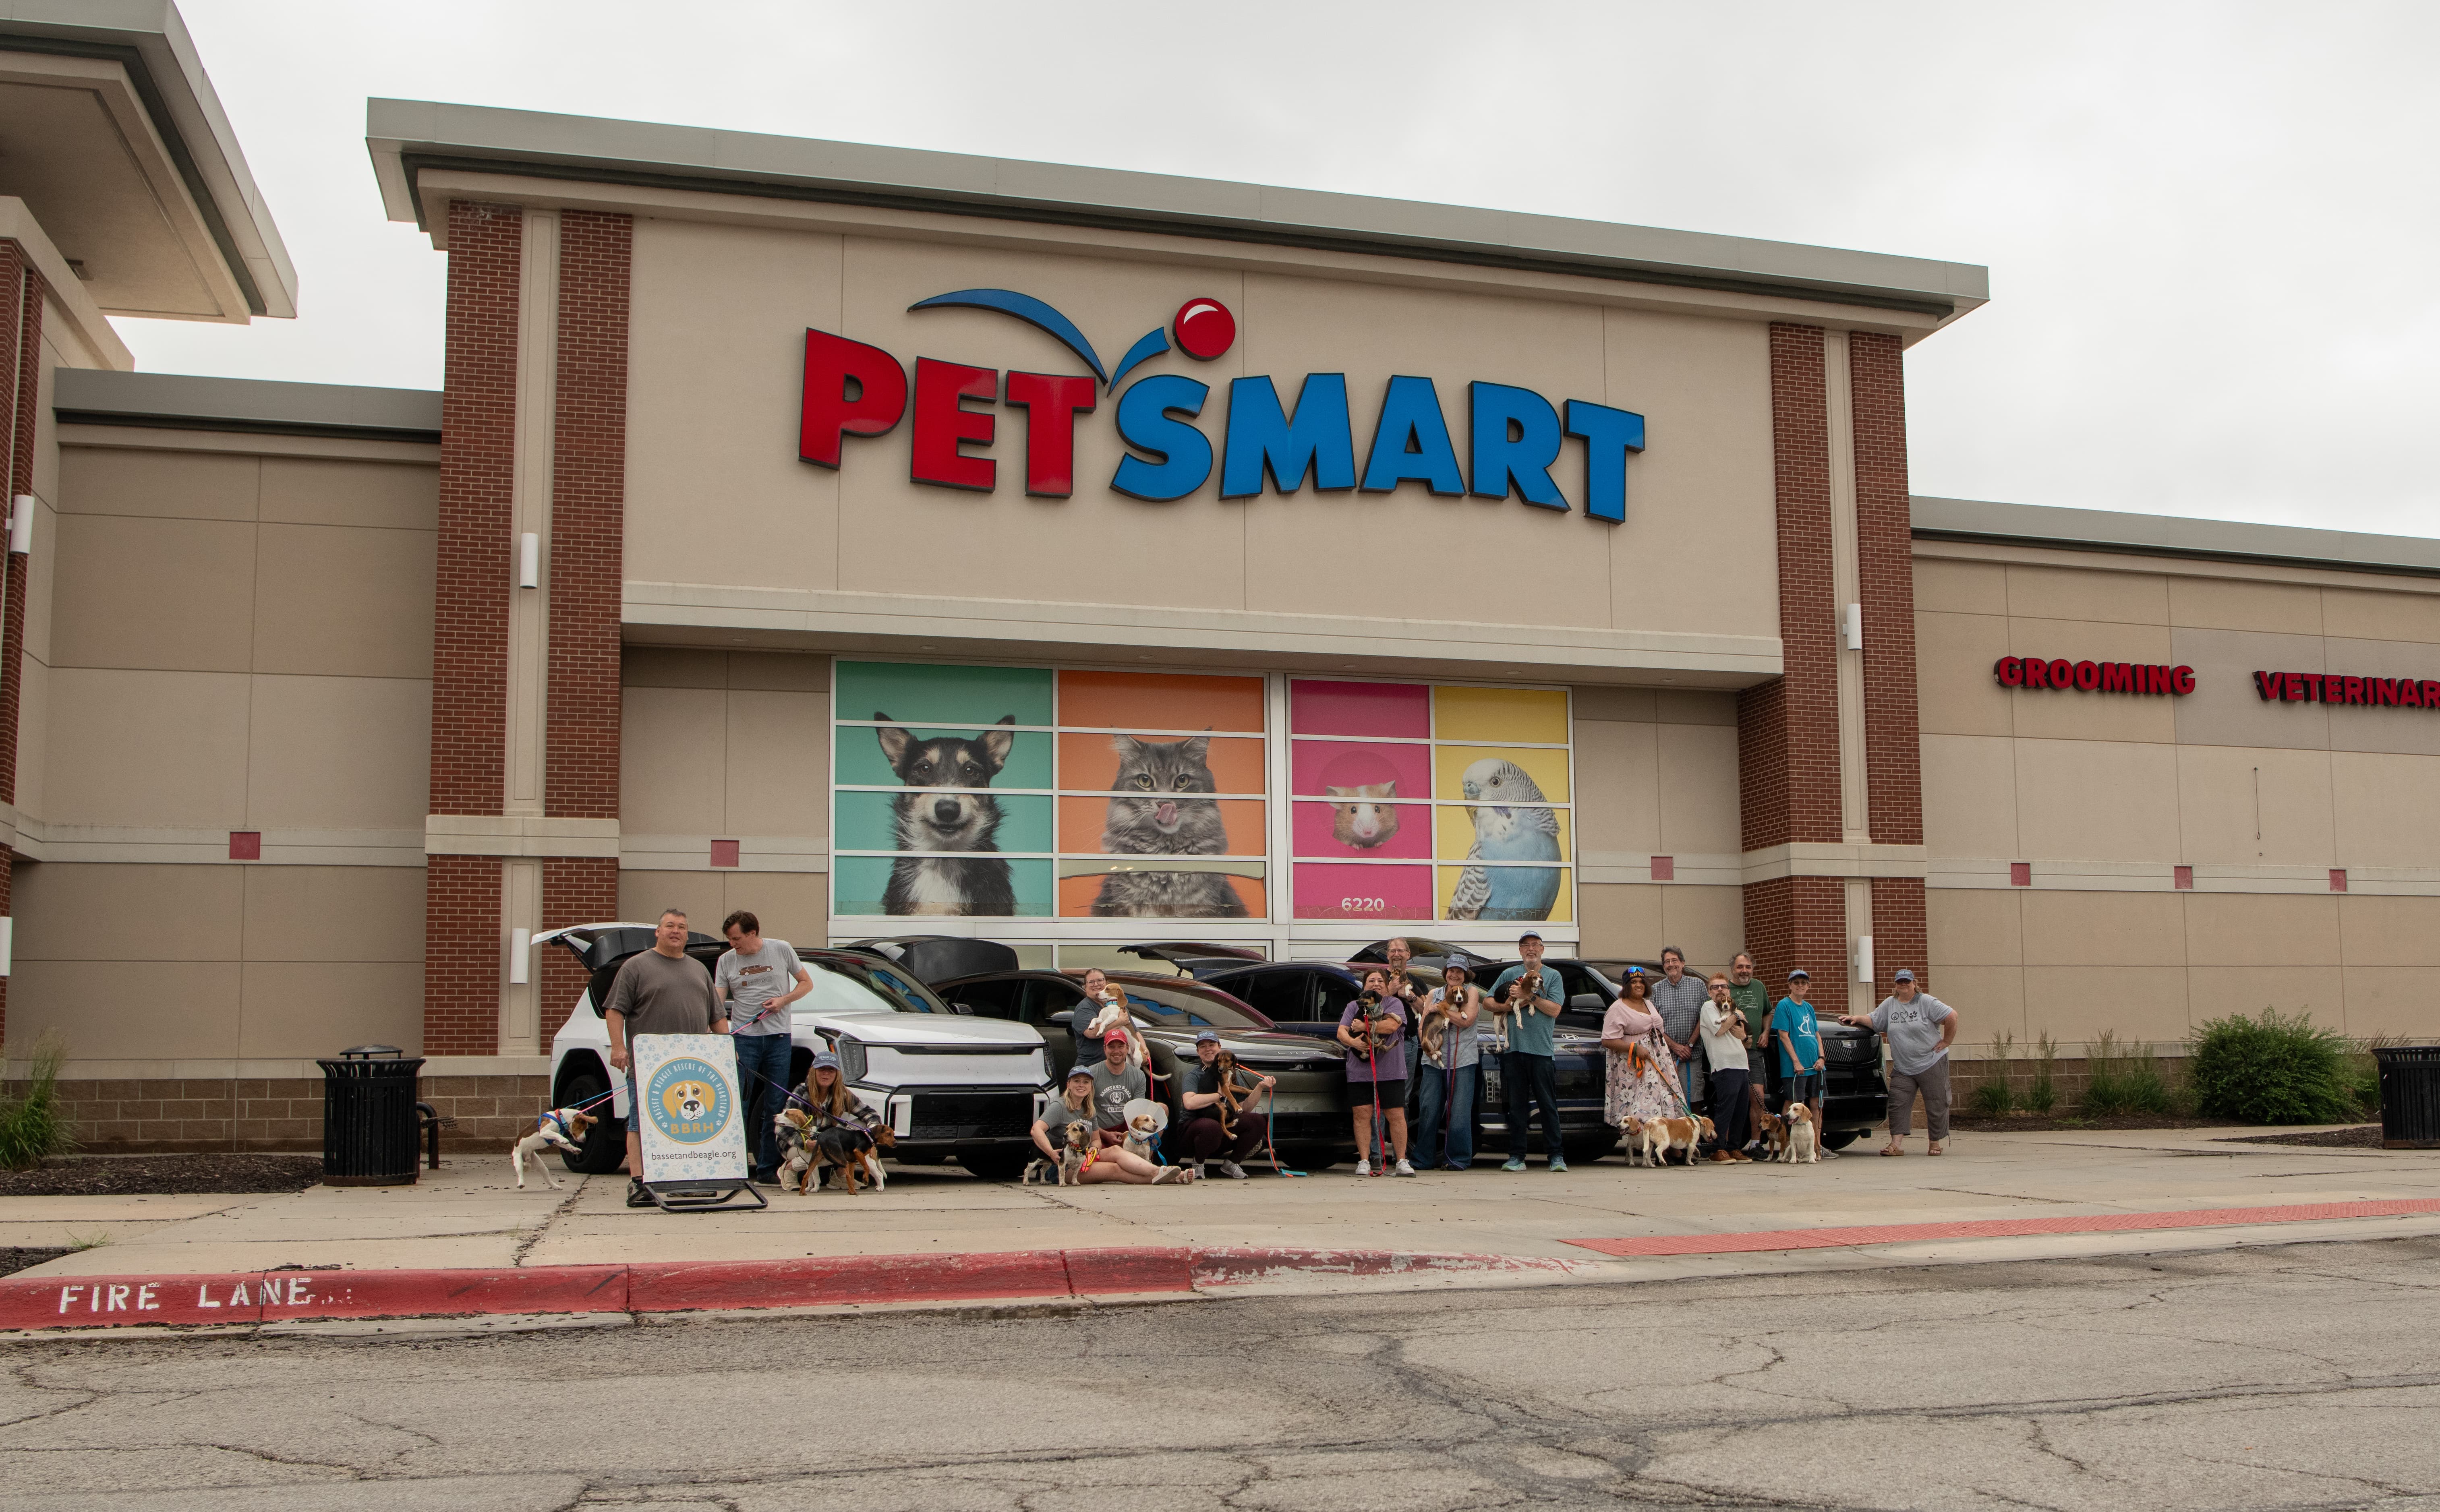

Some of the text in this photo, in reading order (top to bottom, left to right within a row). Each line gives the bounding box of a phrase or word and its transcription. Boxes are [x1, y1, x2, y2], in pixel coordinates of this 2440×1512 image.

[799, 327, 1645, 525] PETSMART
[1994, 656, 2196, 695] GROOMING
[2252, 670, 2440, 708] VETERINAR
[1342, 898, 1384, 911] 6220
[673, 1063, 696, 1072] RESCUE
[698, 1065, 706, 1073] OF
[655, 1069, 672, 1088] BEAGLE
[707, 1071, 718, 1082] THE
[1100, 1086, 1112, 1097] BASSET
[715, 1083, 727, 1117] HEARTLAND
[652, 1098, 664, 1120] BASSET
[670, 1122, 714, 1134] BBRH
[652, 1150, 737, 1160] bassetandbeagle.org
[59, 1277, 316, 1313] FIRE LANE
